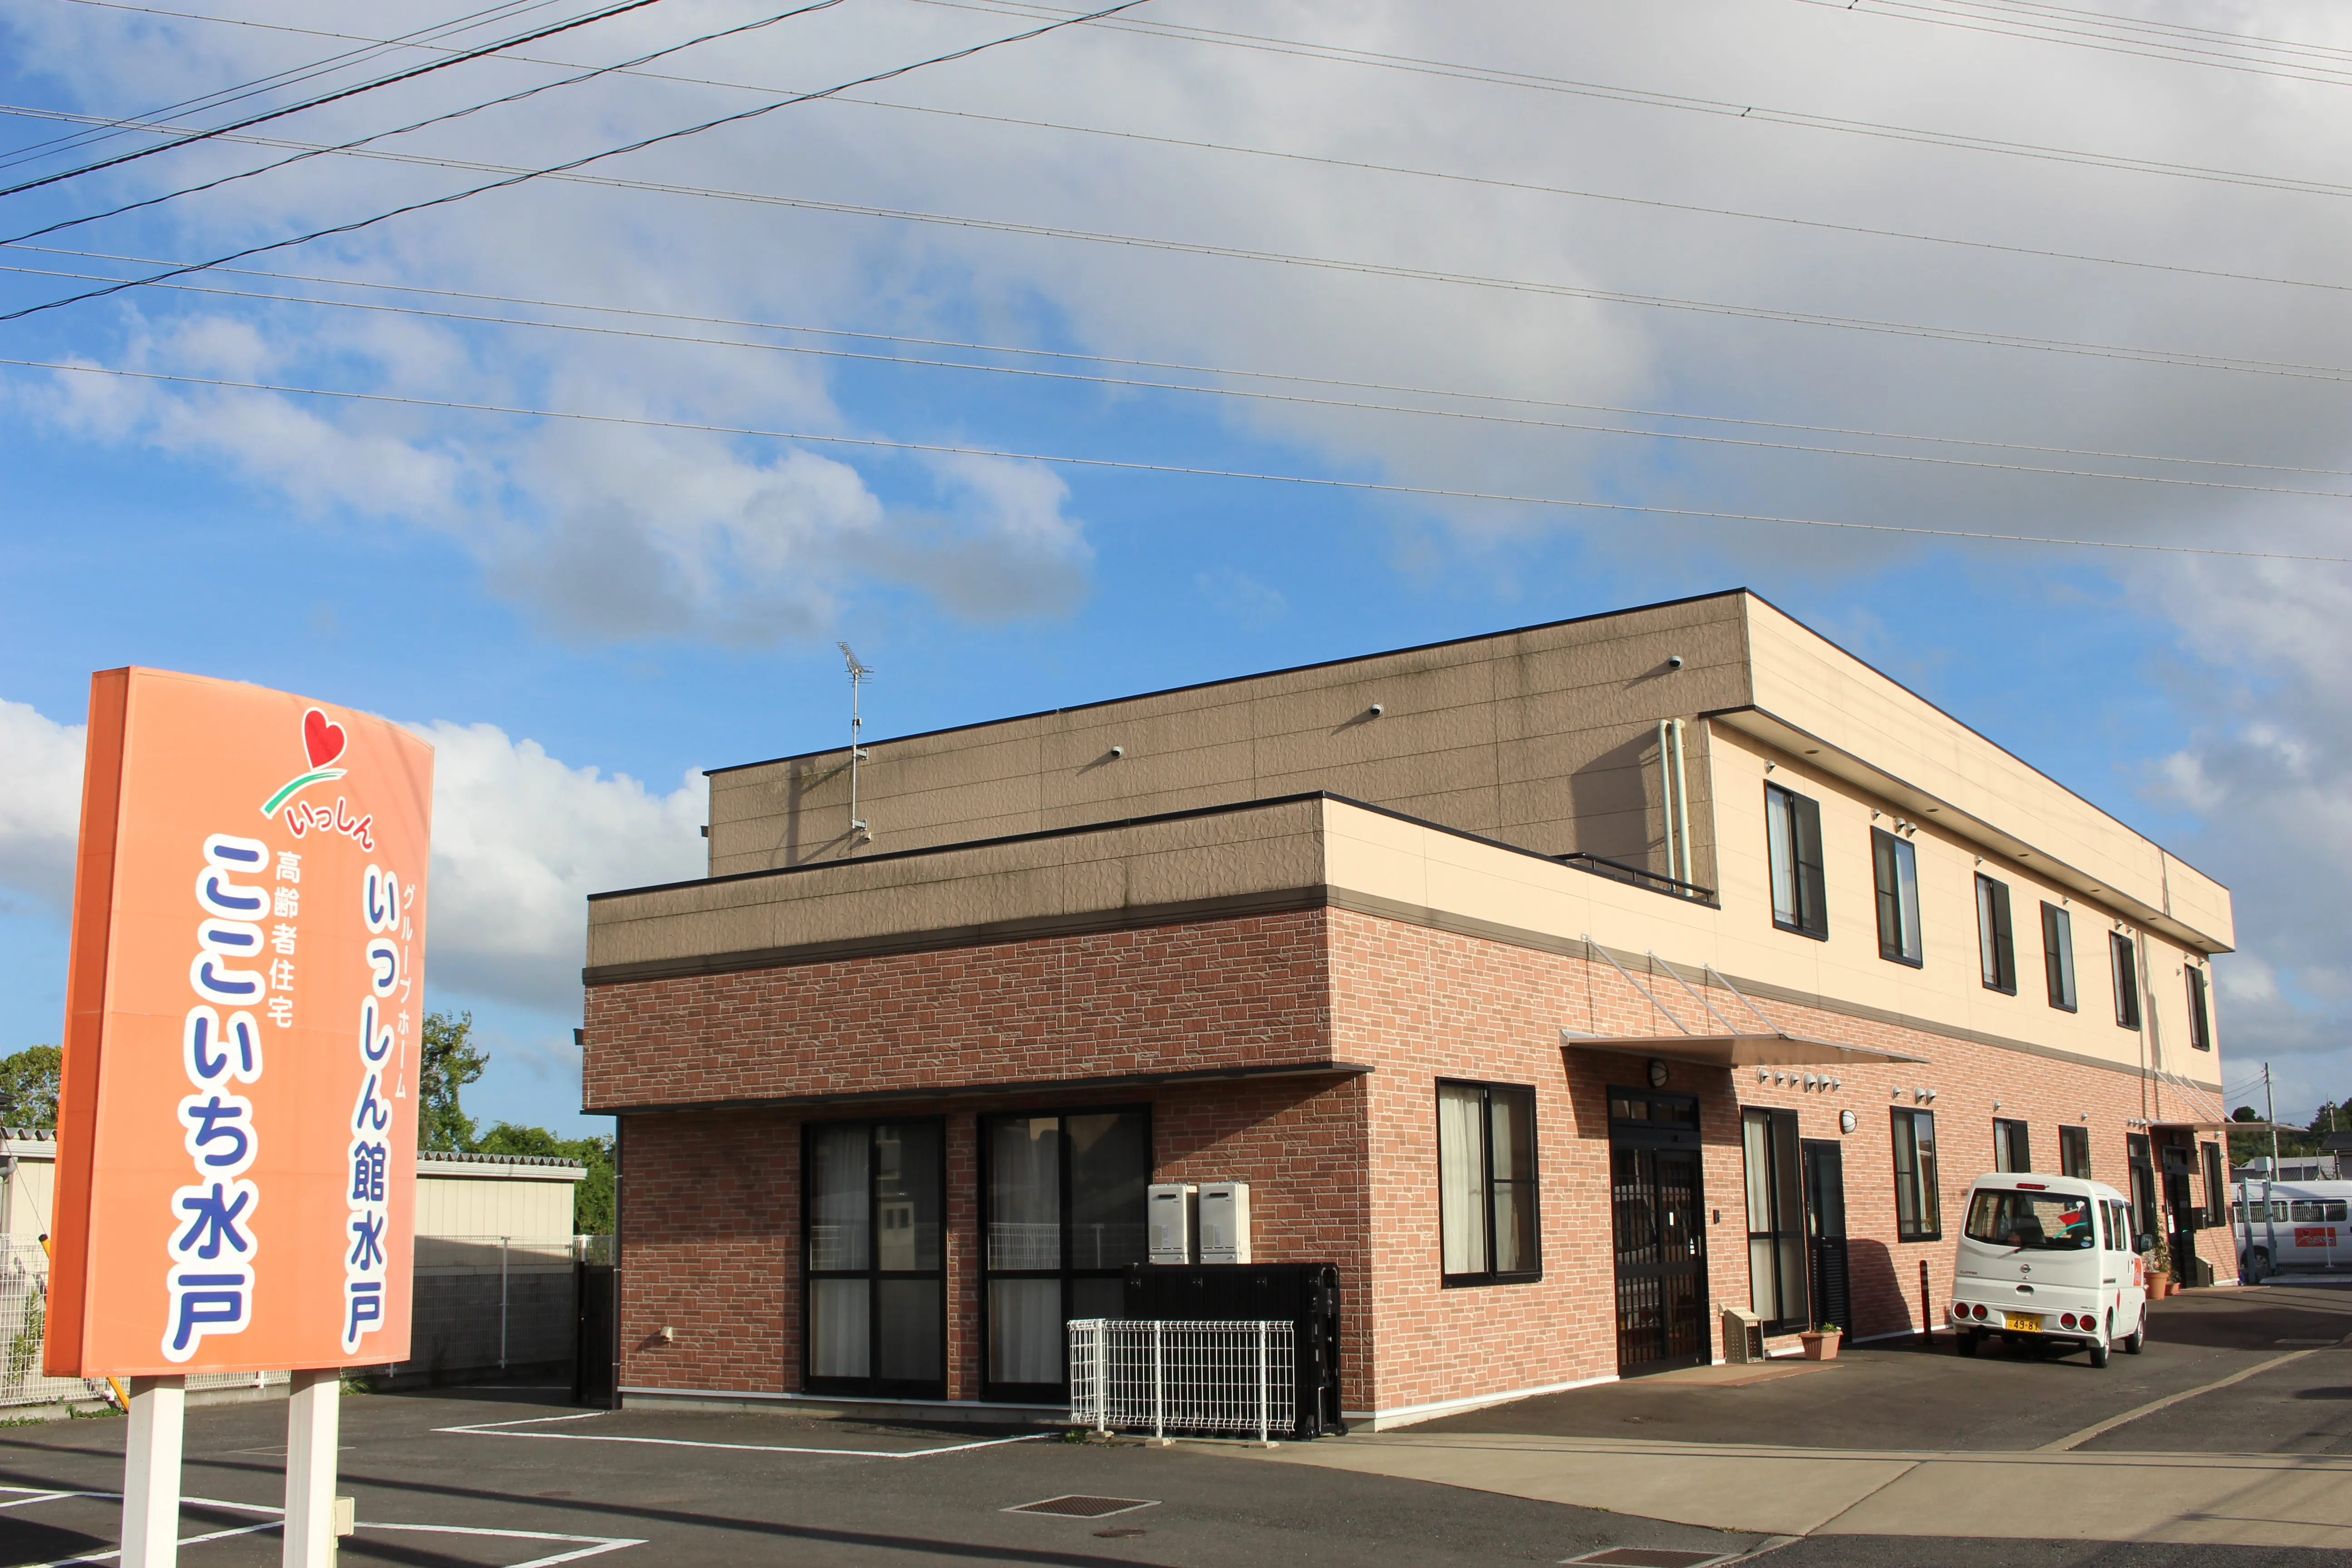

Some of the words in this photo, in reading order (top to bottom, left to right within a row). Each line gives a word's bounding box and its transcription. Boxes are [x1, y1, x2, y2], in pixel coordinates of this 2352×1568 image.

[285, 797, 374, 852] いっしん
[267, 850, 302, 1028] 高齢者住宅
[395, 883, 416, 1099] グループホーム
[162, 834, 270, 1362] ここいち水戸
[342, 864, 400, 1354] いっしん館水戸
[2014, 1320, 2038, 1330] 49-81
